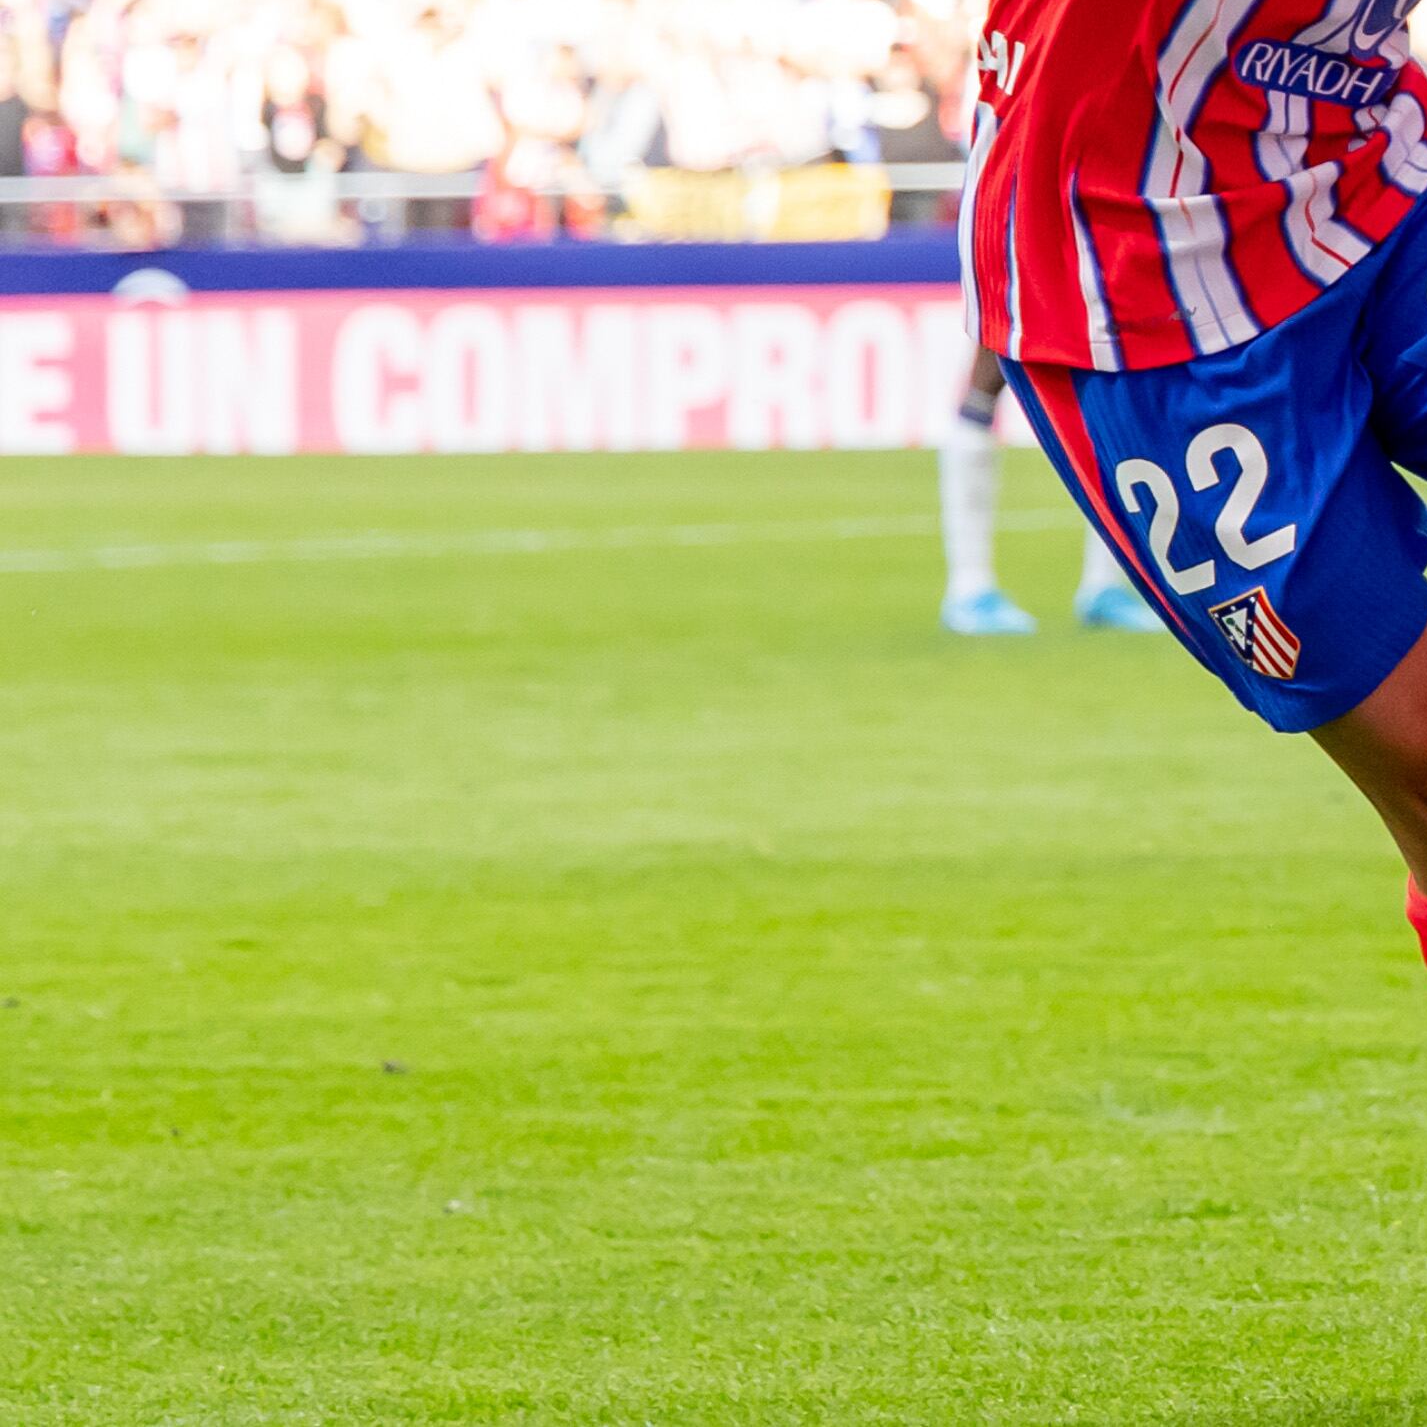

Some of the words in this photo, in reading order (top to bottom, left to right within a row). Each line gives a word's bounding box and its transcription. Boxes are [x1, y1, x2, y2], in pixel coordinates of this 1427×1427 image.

[1241, 42, 1383, 104] RIYADH
[106, 308, 298, 456] UN
[1115, 422, 1299, 596] 22
